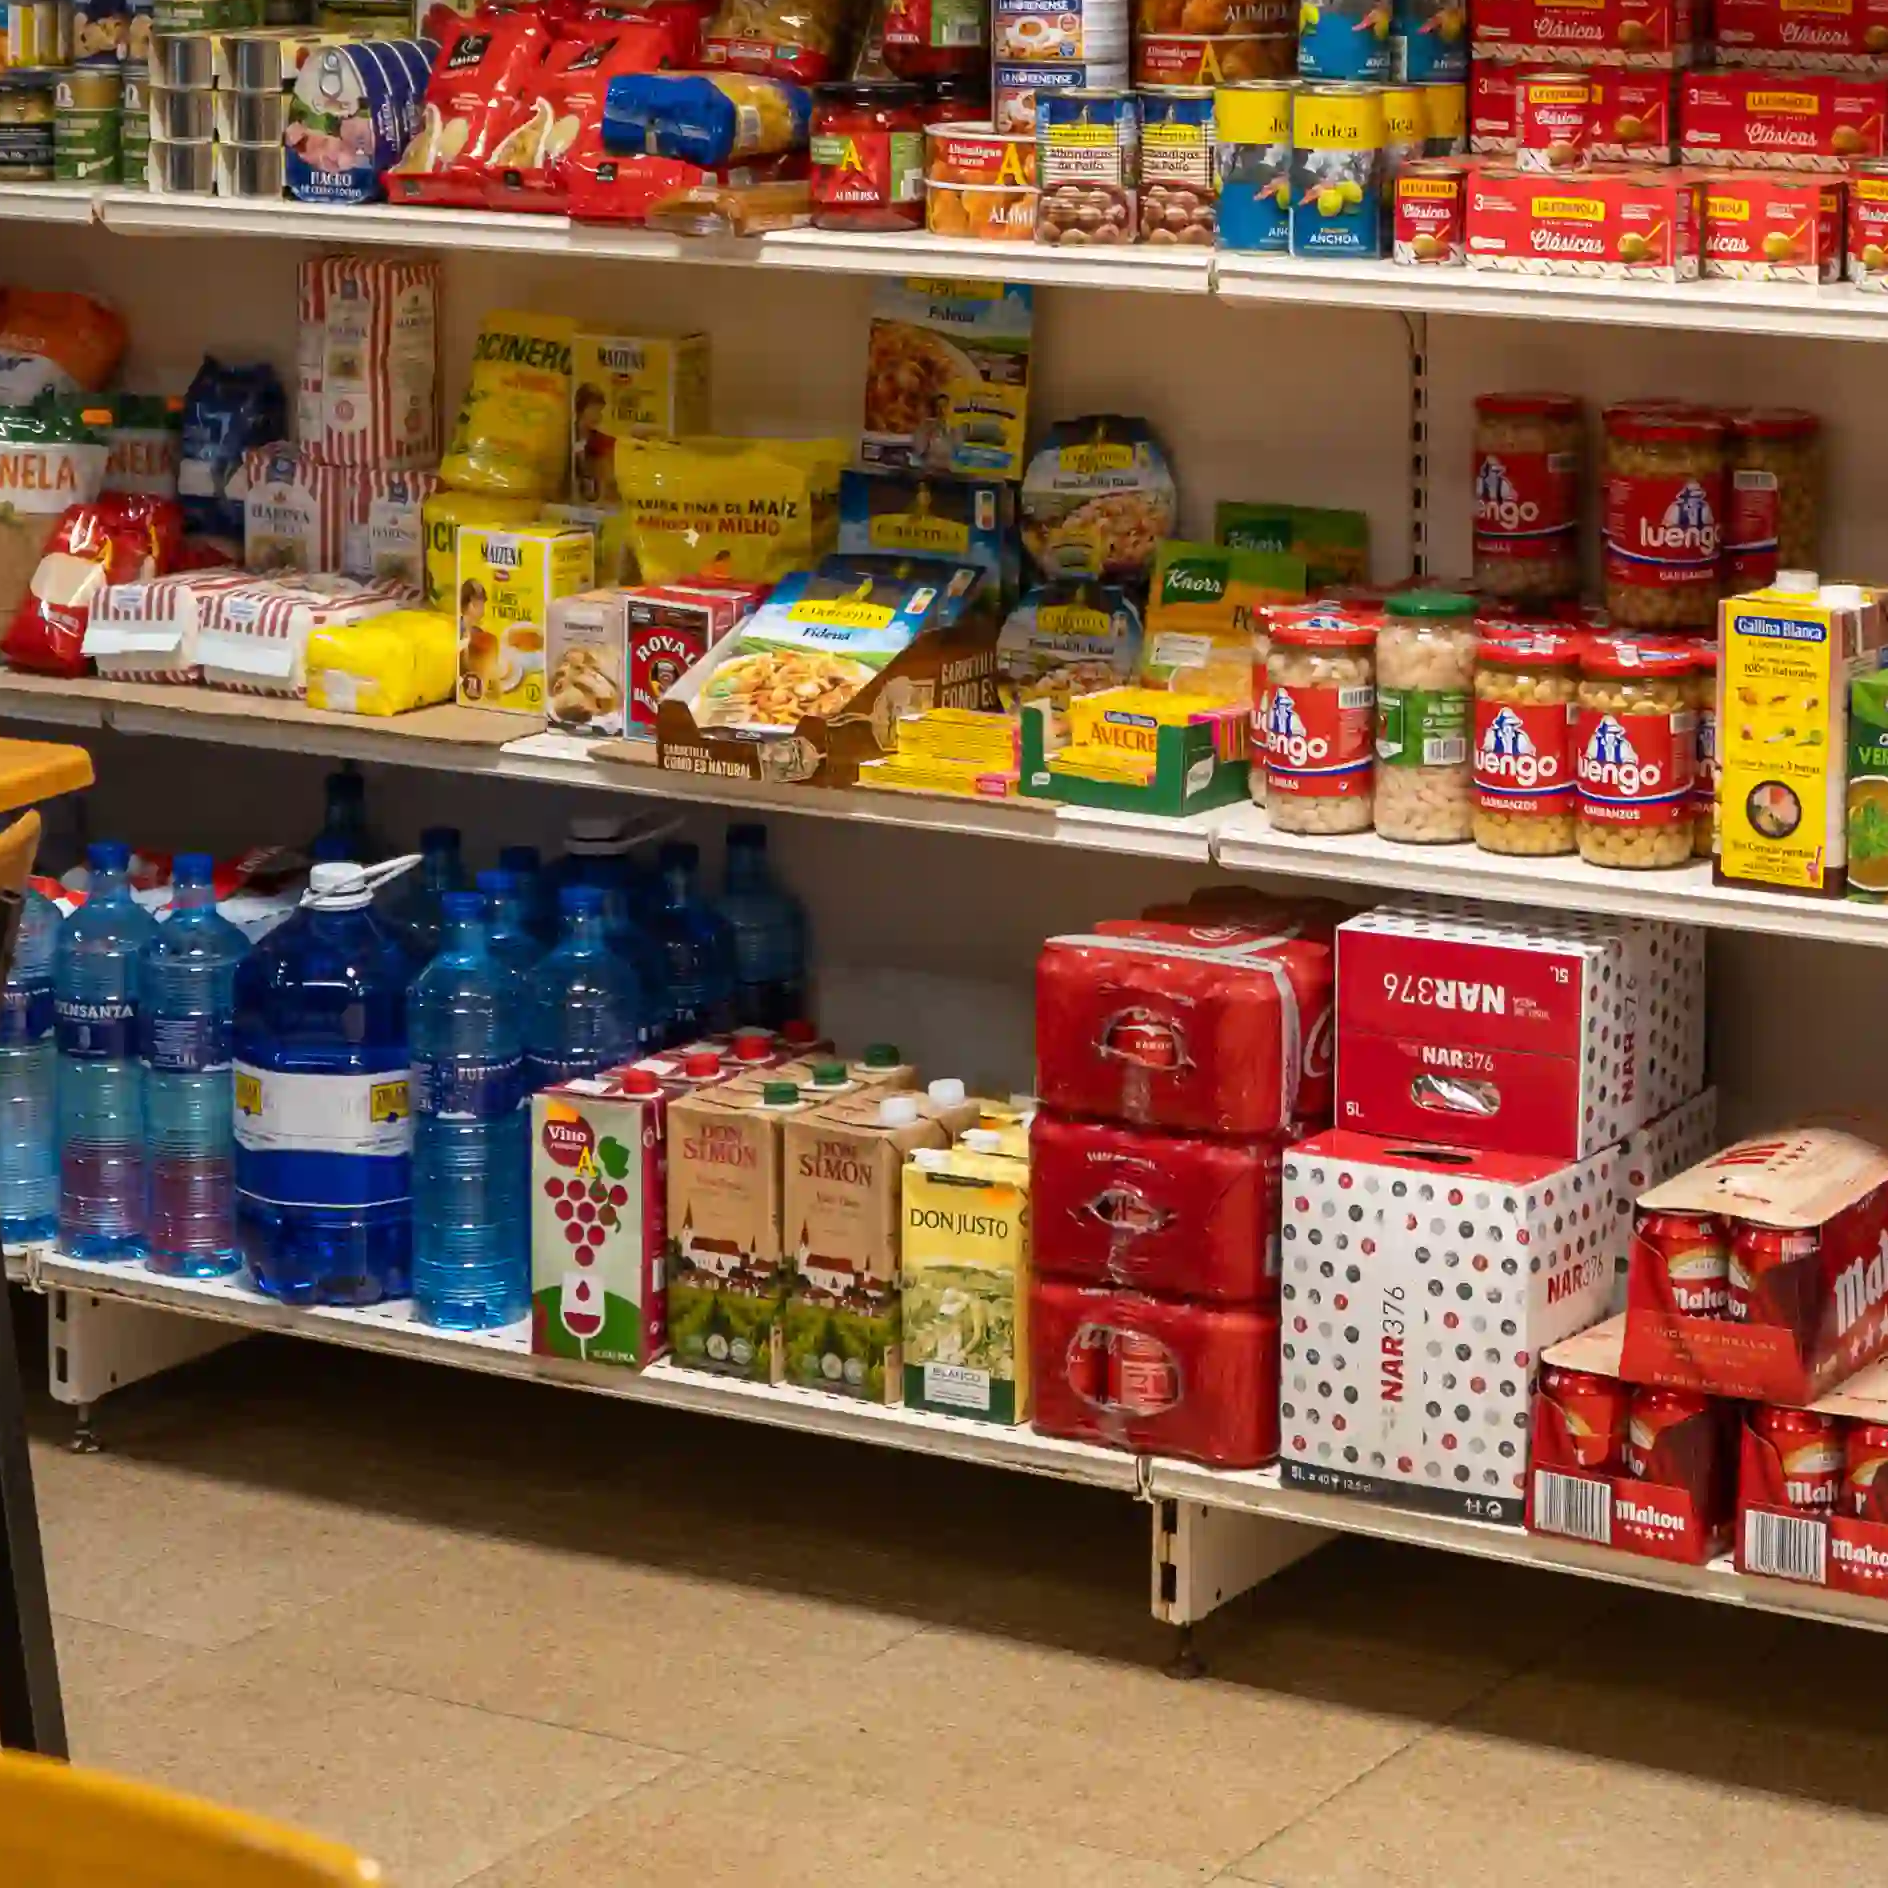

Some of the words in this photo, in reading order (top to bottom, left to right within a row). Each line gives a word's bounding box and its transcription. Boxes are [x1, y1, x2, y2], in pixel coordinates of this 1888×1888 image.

[1533, 16, 1605, 41] Clásicas
[1310, 123, 1358, 142] Jolca
[1474, 195, 1485, 210] 3
[1309, 231, 1360, 245] ANCHOA
[1530, 227, 1606, 254] Clásicas
[748, 496, 798, 518] MAÍZ
[480, 543, 523, 568] MAIZENA
[1167, 566, 1223, 594] Knorr
[1737, 616, 1782, 637] Gallina
[1783, 617, 1824, 640] Blanca
[636, 633, 696, 664] ROYAL
[940, 685, 978, 709] COMO
[663, 757, 691, 772] COMO
[693, 759, 706, 774] ES
[707, 759, 752, 778] NATURAL
[1383, 973, 1505, 1015] NAR376
[1422, 1045, 1495, 1073] NAR376
[548, 1124, 587, 1144] Vino
[700, 1124, 742, 1144] DON
[815, 1138, 858, 1160] DON
[910, 1208, 955, 1230] DON
[956, 1211, 1009, 1239] JUSTO
[1379, 1284, 1406, 1403] NAR376
[931, 1367, 981, 1383] BLANCO
